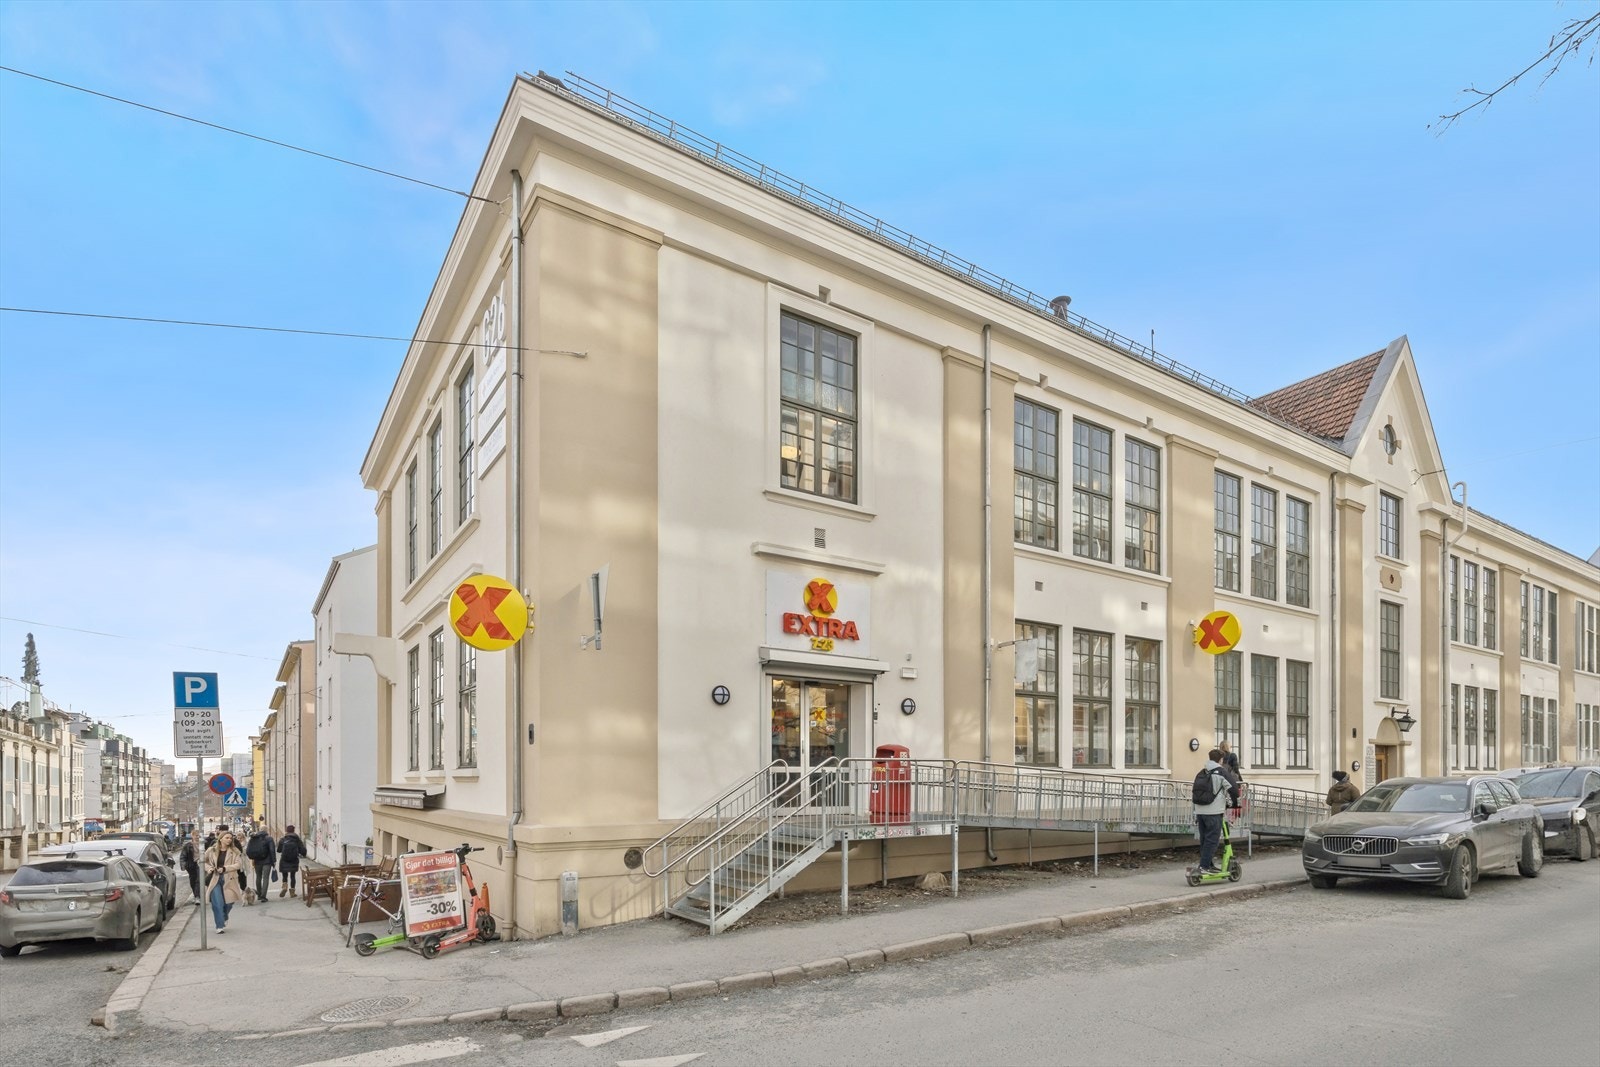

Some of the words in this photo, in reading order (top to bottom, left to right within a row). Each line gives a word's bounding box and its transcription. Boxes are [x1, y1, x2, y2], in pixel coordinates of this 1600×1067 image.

[782, 612, 860, 641] EXTRA
[184, 676, 208, 704] P
[422, 859, 434, 867] det
[435, 855, 455, 865] billig!
[426, 900, 457, 915] -30%
